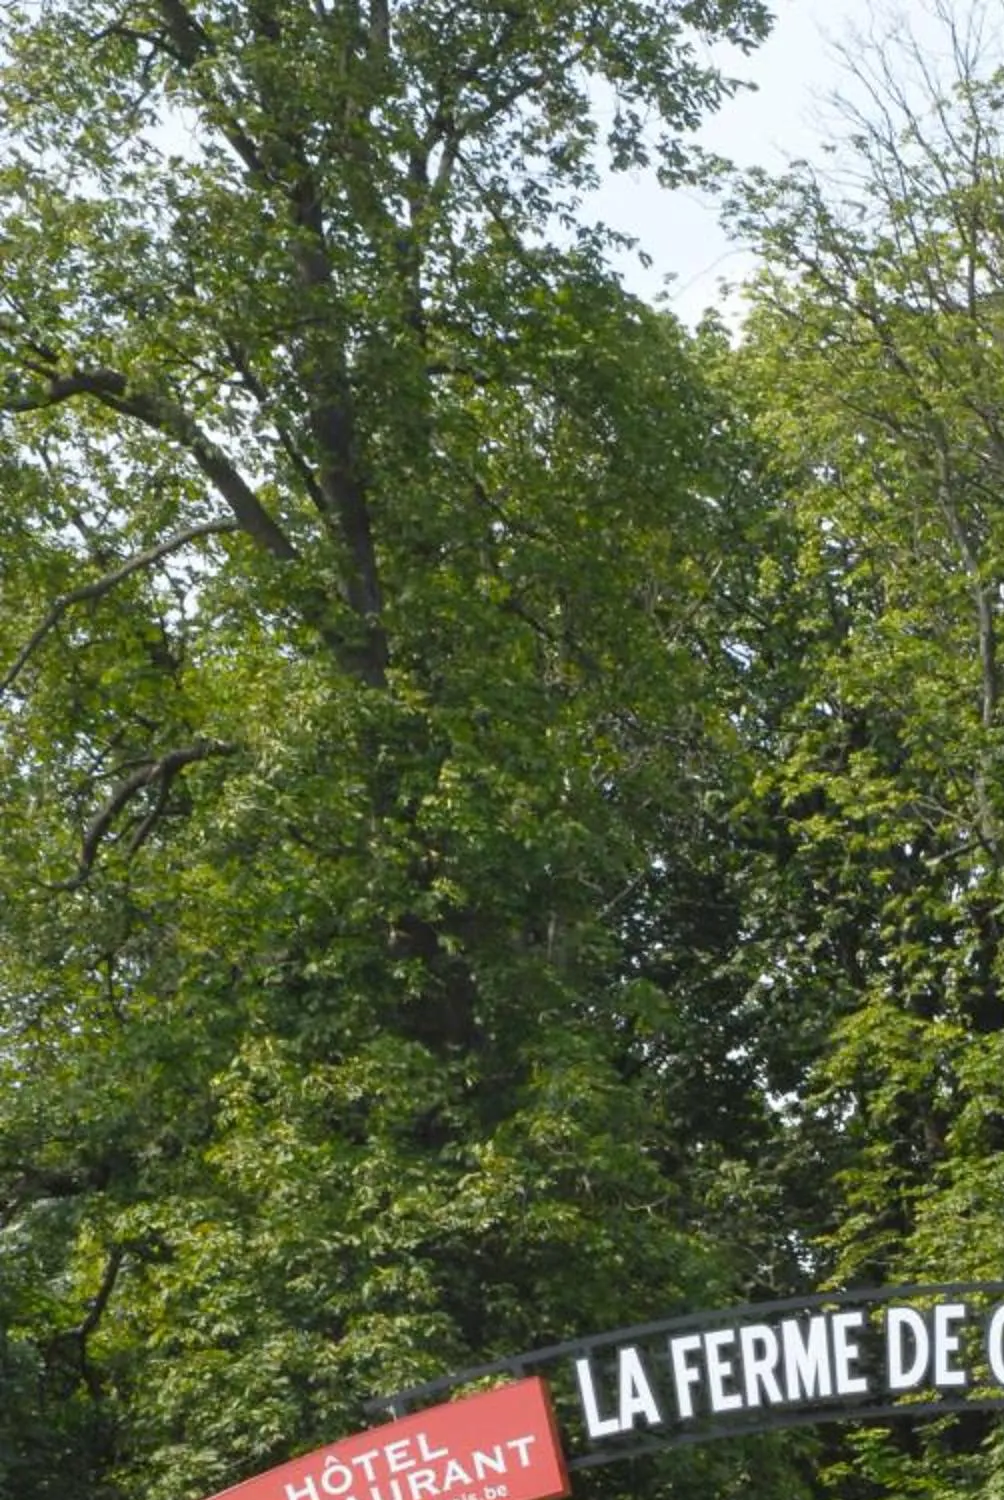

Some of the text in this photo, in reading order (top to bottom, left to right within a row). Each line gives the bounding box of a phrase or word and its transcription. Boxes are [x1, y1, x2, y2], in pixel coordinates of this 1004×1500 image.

[576, 1347, 661, 1438] LA
[670, 1313, 867, 1418] FERME
[888, 1304, 965, 1388] DE
